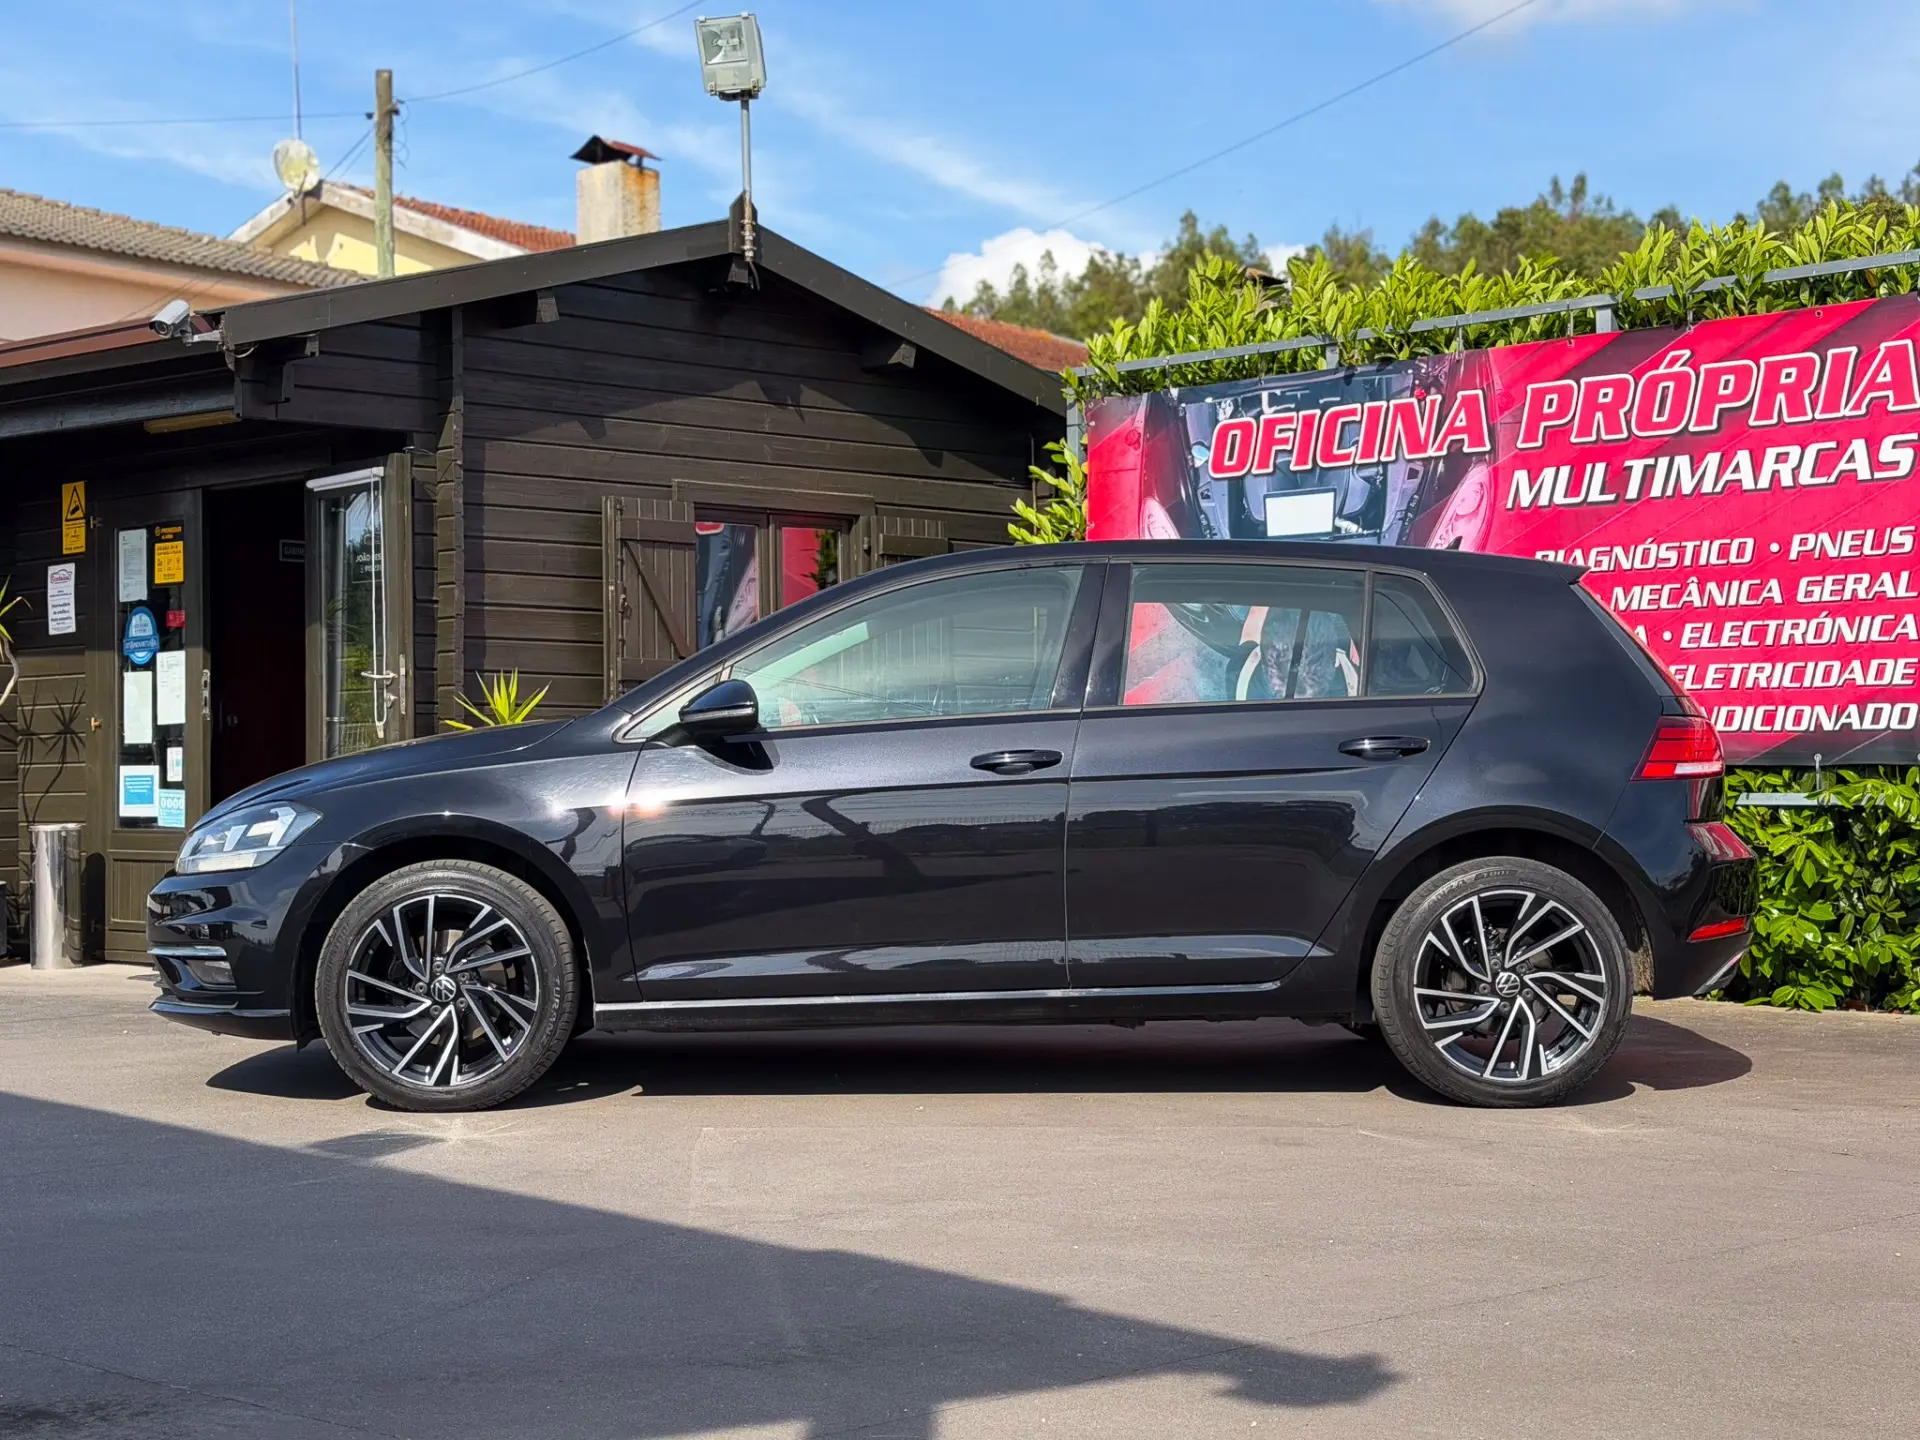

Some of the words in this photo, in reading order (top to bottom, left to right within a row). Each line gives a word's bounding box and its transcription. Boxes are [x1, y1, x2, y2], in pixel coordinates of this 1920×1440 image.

[1208, 389, 1491, 478] OFICINA
[1516, 338, 1920, 450] PRÓPRIA
[1506, 433, 1918, 510] MULTIMARCAS
[1788, 526, 1916, 561] PNEUS
[1610, 576, 1784, 612] MECÂNICA
[1796, 570, 1919, 604] GERAL
[1680, 611, 1919, 649] ELECTRÓNICA
